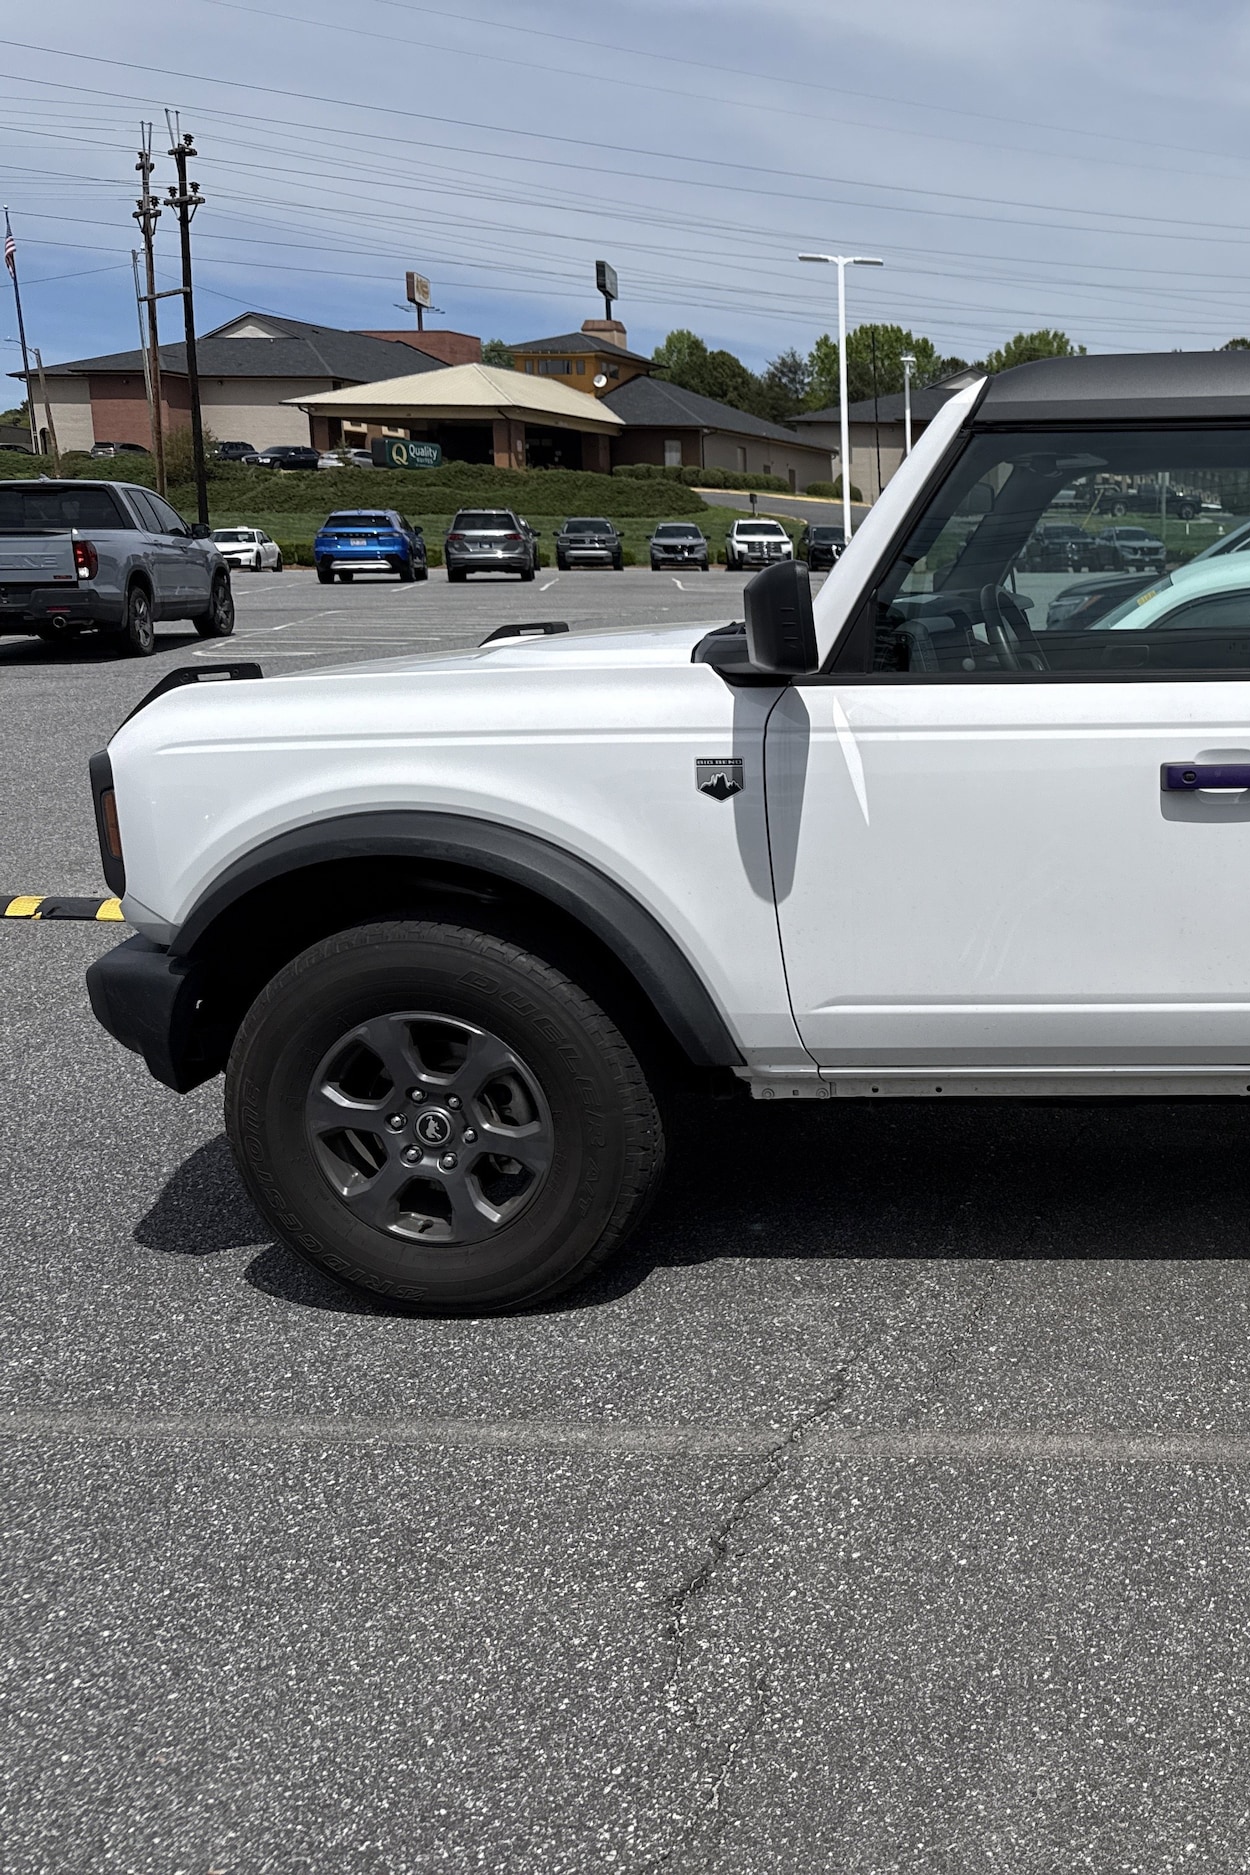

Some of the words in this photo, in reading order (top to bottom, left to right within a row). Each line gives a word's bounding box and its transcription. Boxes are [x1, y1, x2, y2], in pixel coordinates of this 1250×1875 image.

[408, 443, 438, 461] Quality
[457, 970, 606, 1148] DUELER
[242, 1078, 429, 1301] BRIDGESTONE
